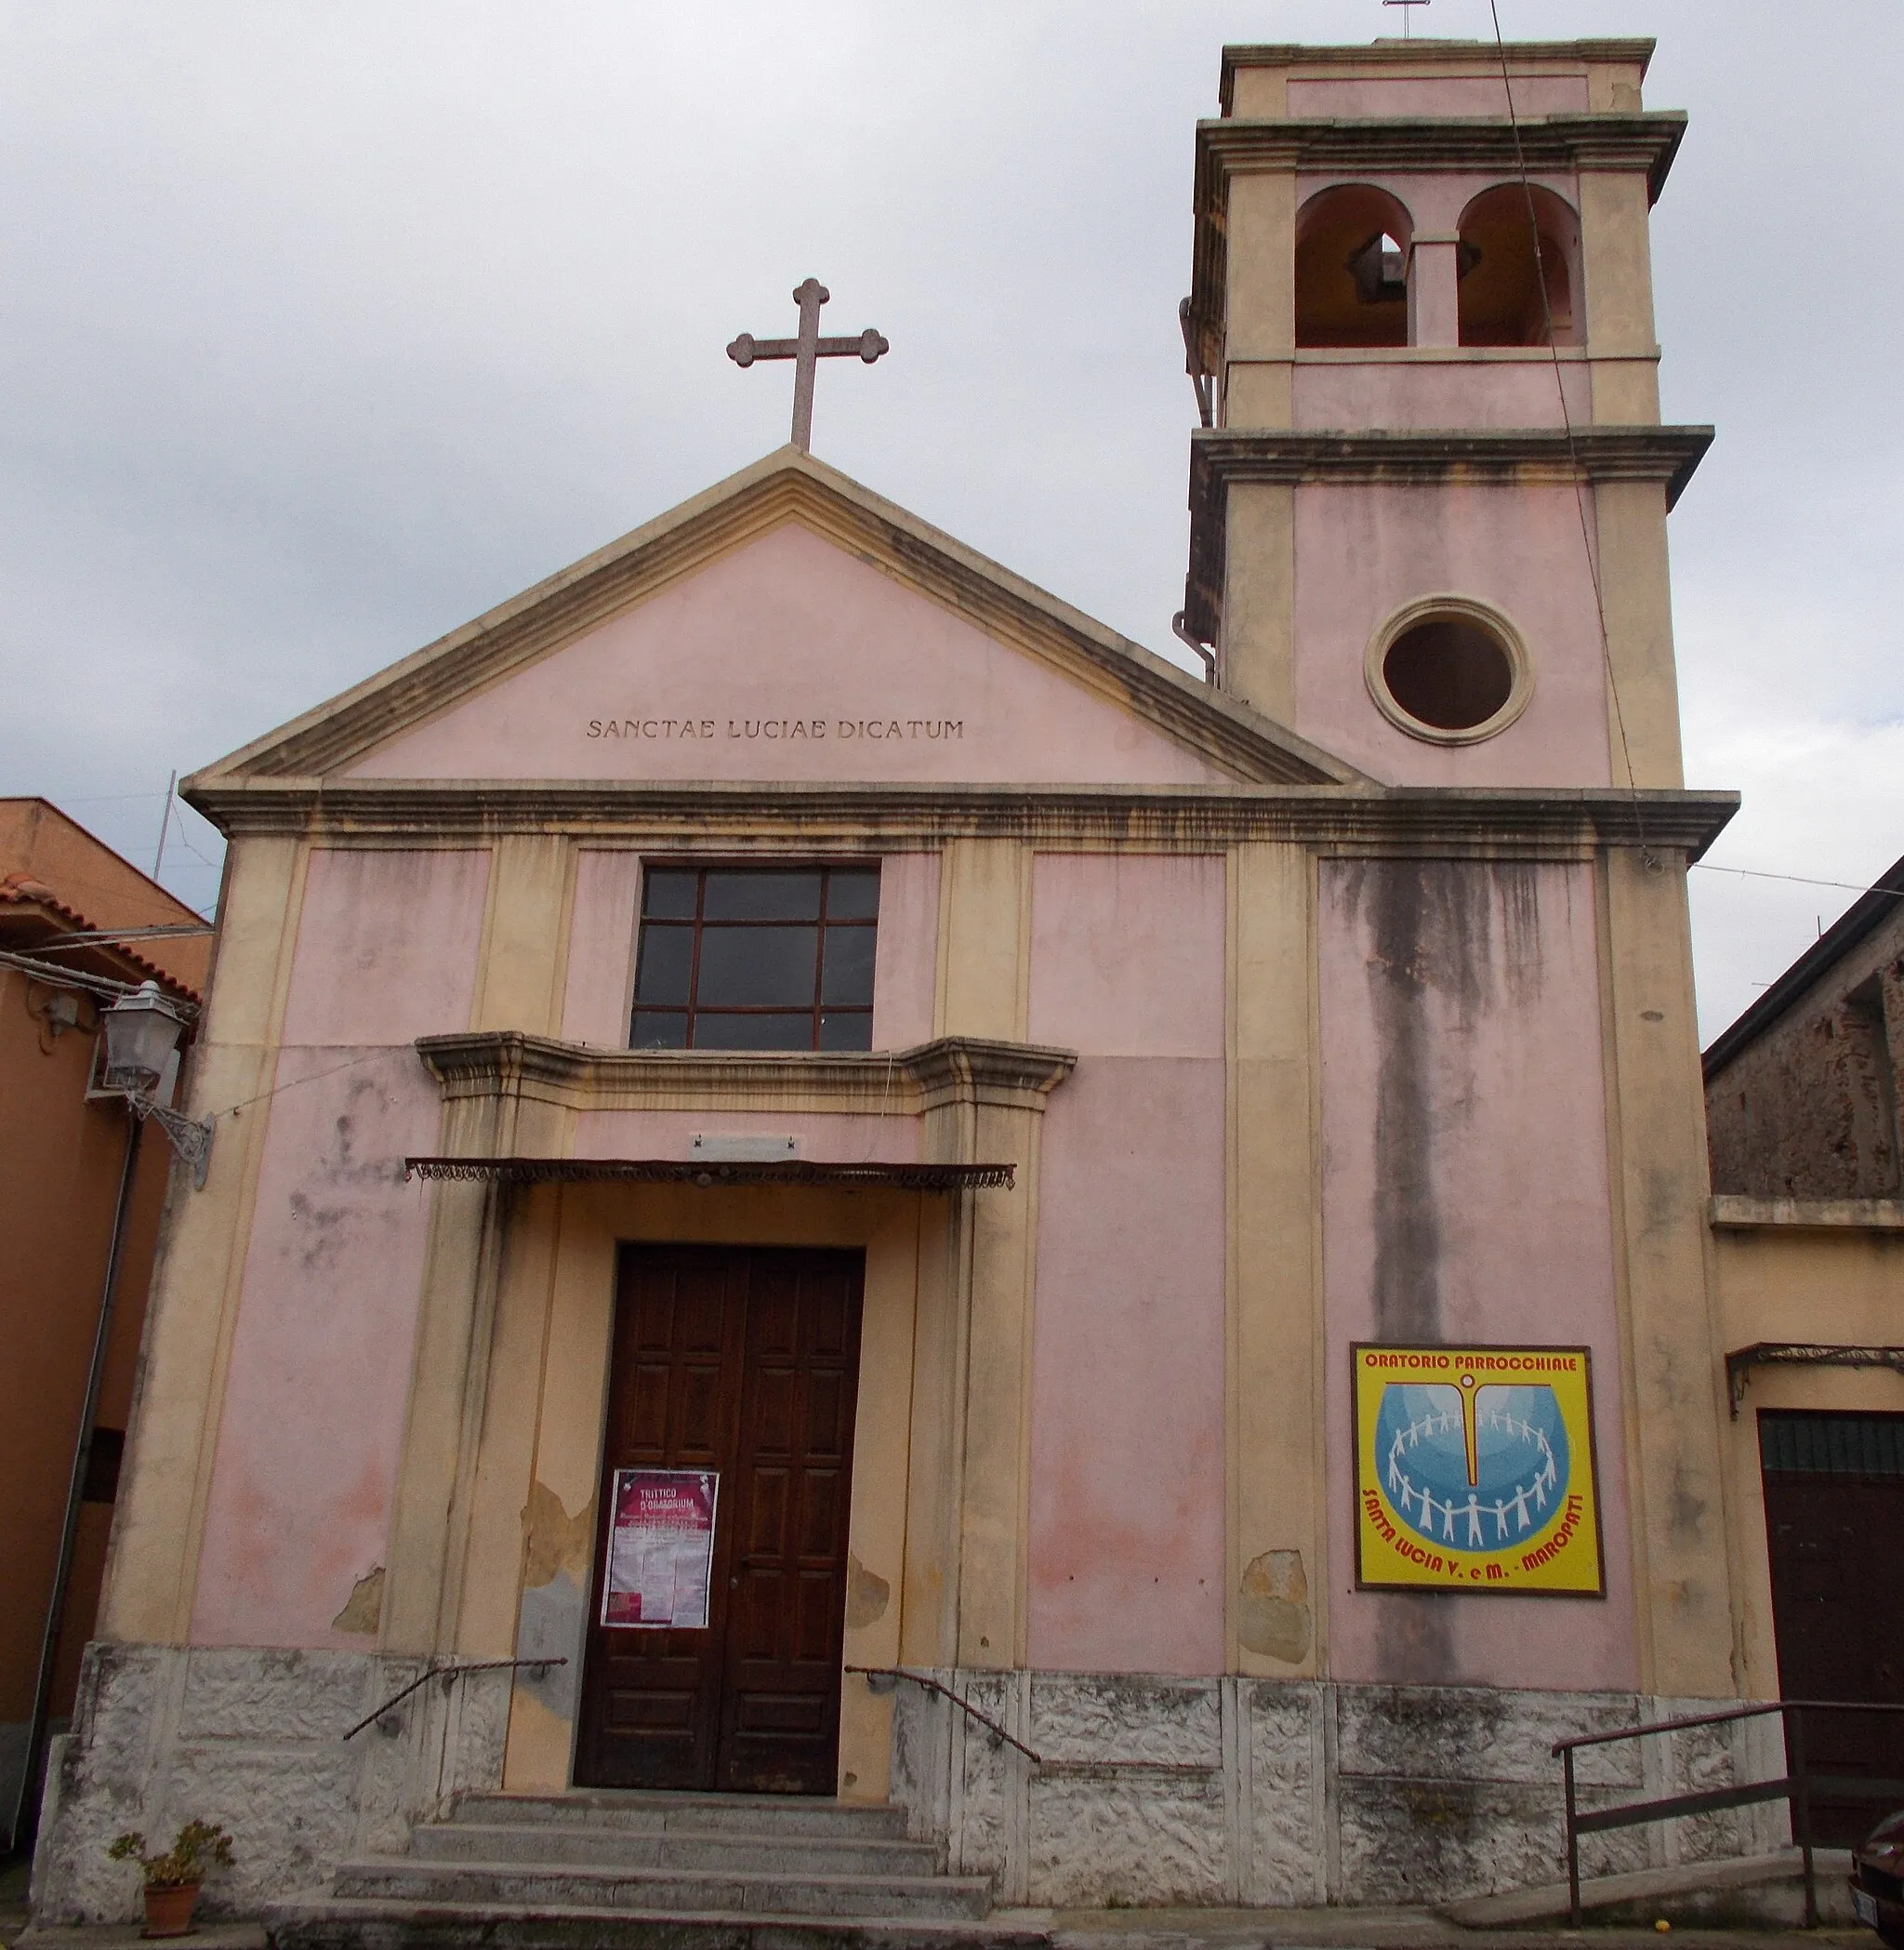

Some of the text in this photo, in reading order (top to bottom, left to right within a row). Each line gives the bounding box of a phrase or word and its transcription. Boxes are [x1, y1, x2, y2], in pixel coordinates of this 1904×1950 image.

[587, 720, 963, 739] SANCTAE LUCIAE DICATUM
[1365, 1353, 1578, 1372] ORATORIO PARROCCHIALE
[640, 1488, 677, 1500] TRITTICO
[1362, 1489, 1396, 1544] SANTA
[1395, 1536, 1444, 1572] LUCIA
[1447, 1560, 1464, 1578] V.
[1521, 1493, 1584, 1572] MAROPATI
